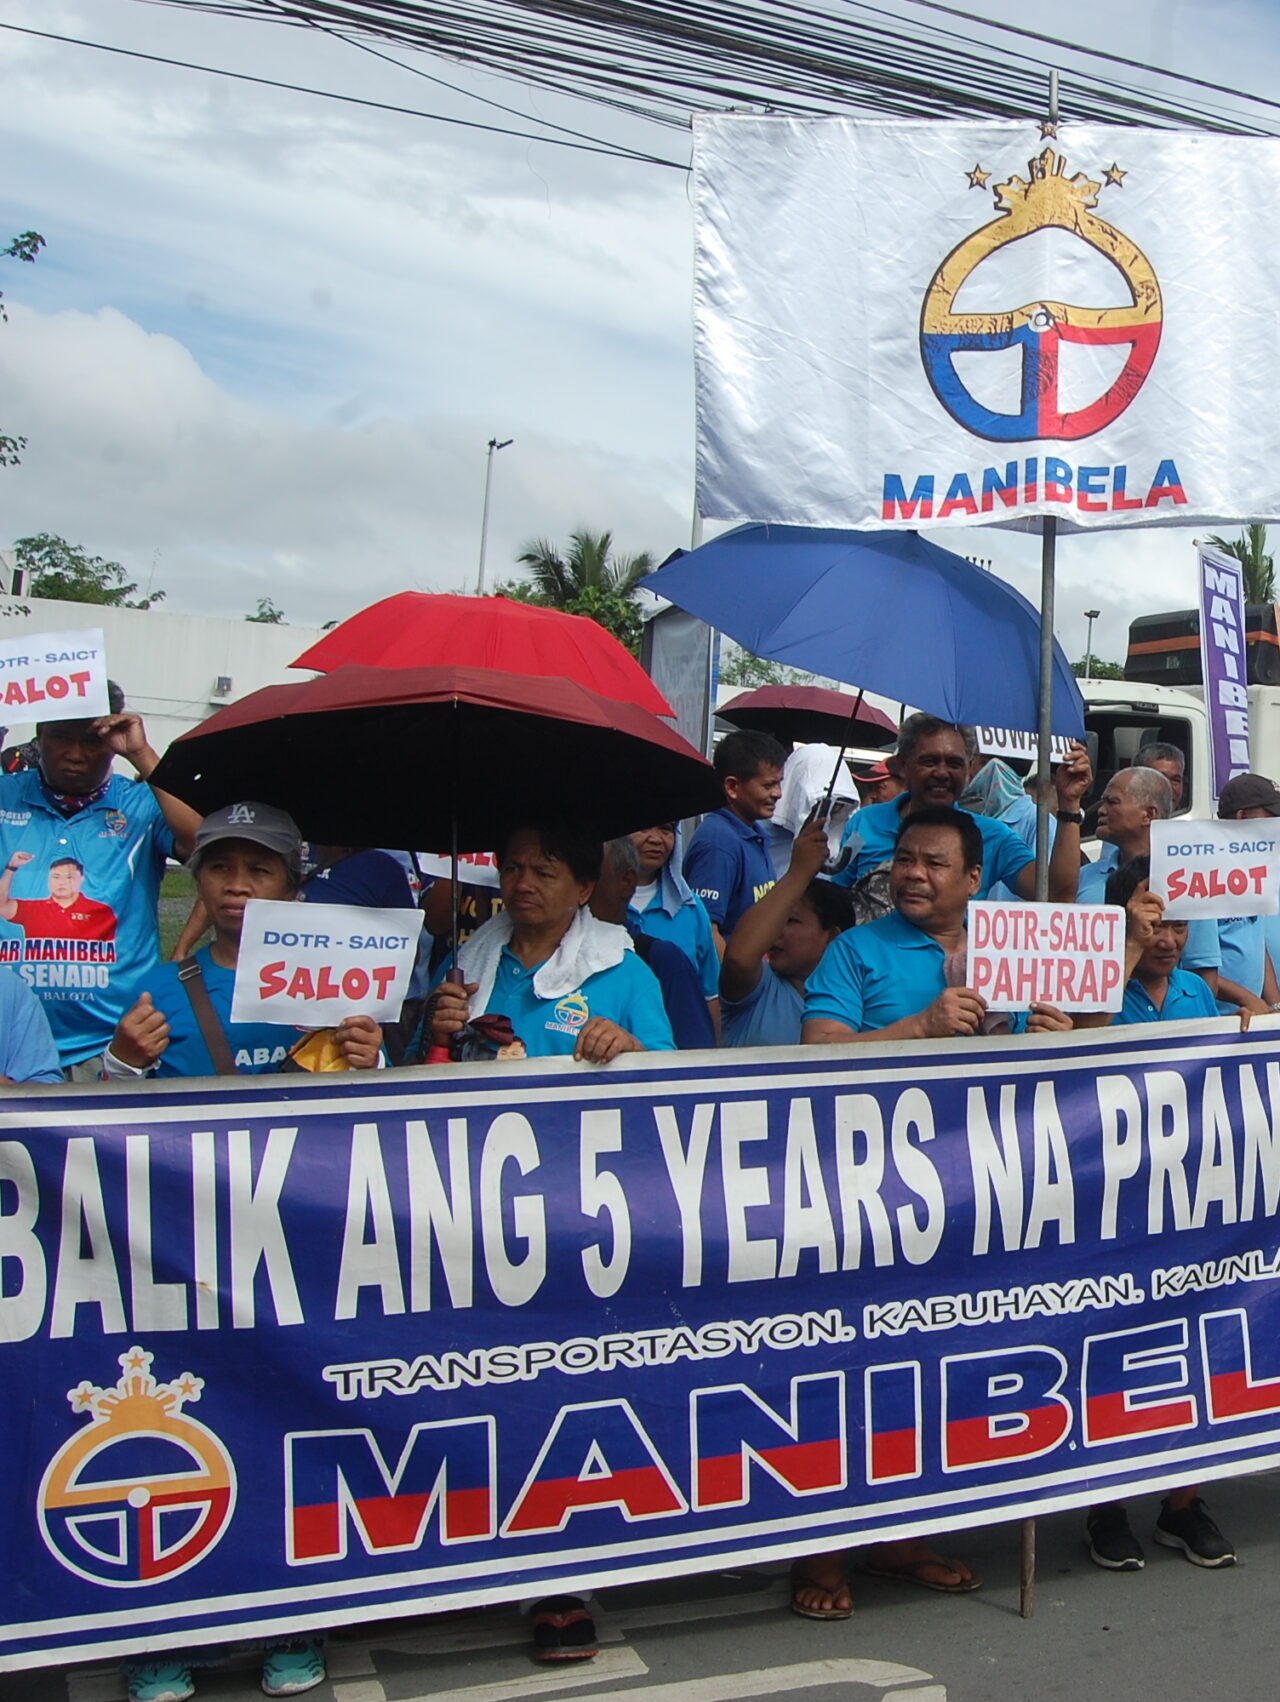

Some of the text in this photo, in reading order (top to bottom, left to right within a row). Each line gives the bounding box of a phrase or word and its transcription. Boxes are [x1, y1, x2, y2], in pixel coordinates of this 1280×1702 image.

[882, 459, 1188, 520] MANIBELA
[45, 650, 98, 663] SAICT
[1204, 563, 1250, 780] MANIBEL
[0, 671, 91, 705] ALOT
[227, 803, 256, 824] LA
[1167, 844, 1215, 857] DOTR
[1229, 841, 1276, 854] SAICT
[1167, 865, 1267, 902] SALOT
[263, 931, 330, 948] DOTR
[349, 935, 410, 951] SAICT
[974, 908, 1119, 951] DOTR-SAICT
[23, 938, 117, 964] MANIBELA
[19, 964, 110, 989] SENADO
[259, 961, 396, 1001] SALOT
[973, 957, 1121, 1004] PAHIRAP
[0, 1126, 305, 1344] BALIK
[335, 1111, 547, 1321] ANG
[579, 1108, 631, 1298] 5
[653, 1086, 945, 1288] YEARS
[967, 1080, 1076, 1256] NA
[324, 1309, 853, 1400] TRANSPORTASYON.
[864, 1271, 1144, 1335] KABUHAYAN.
